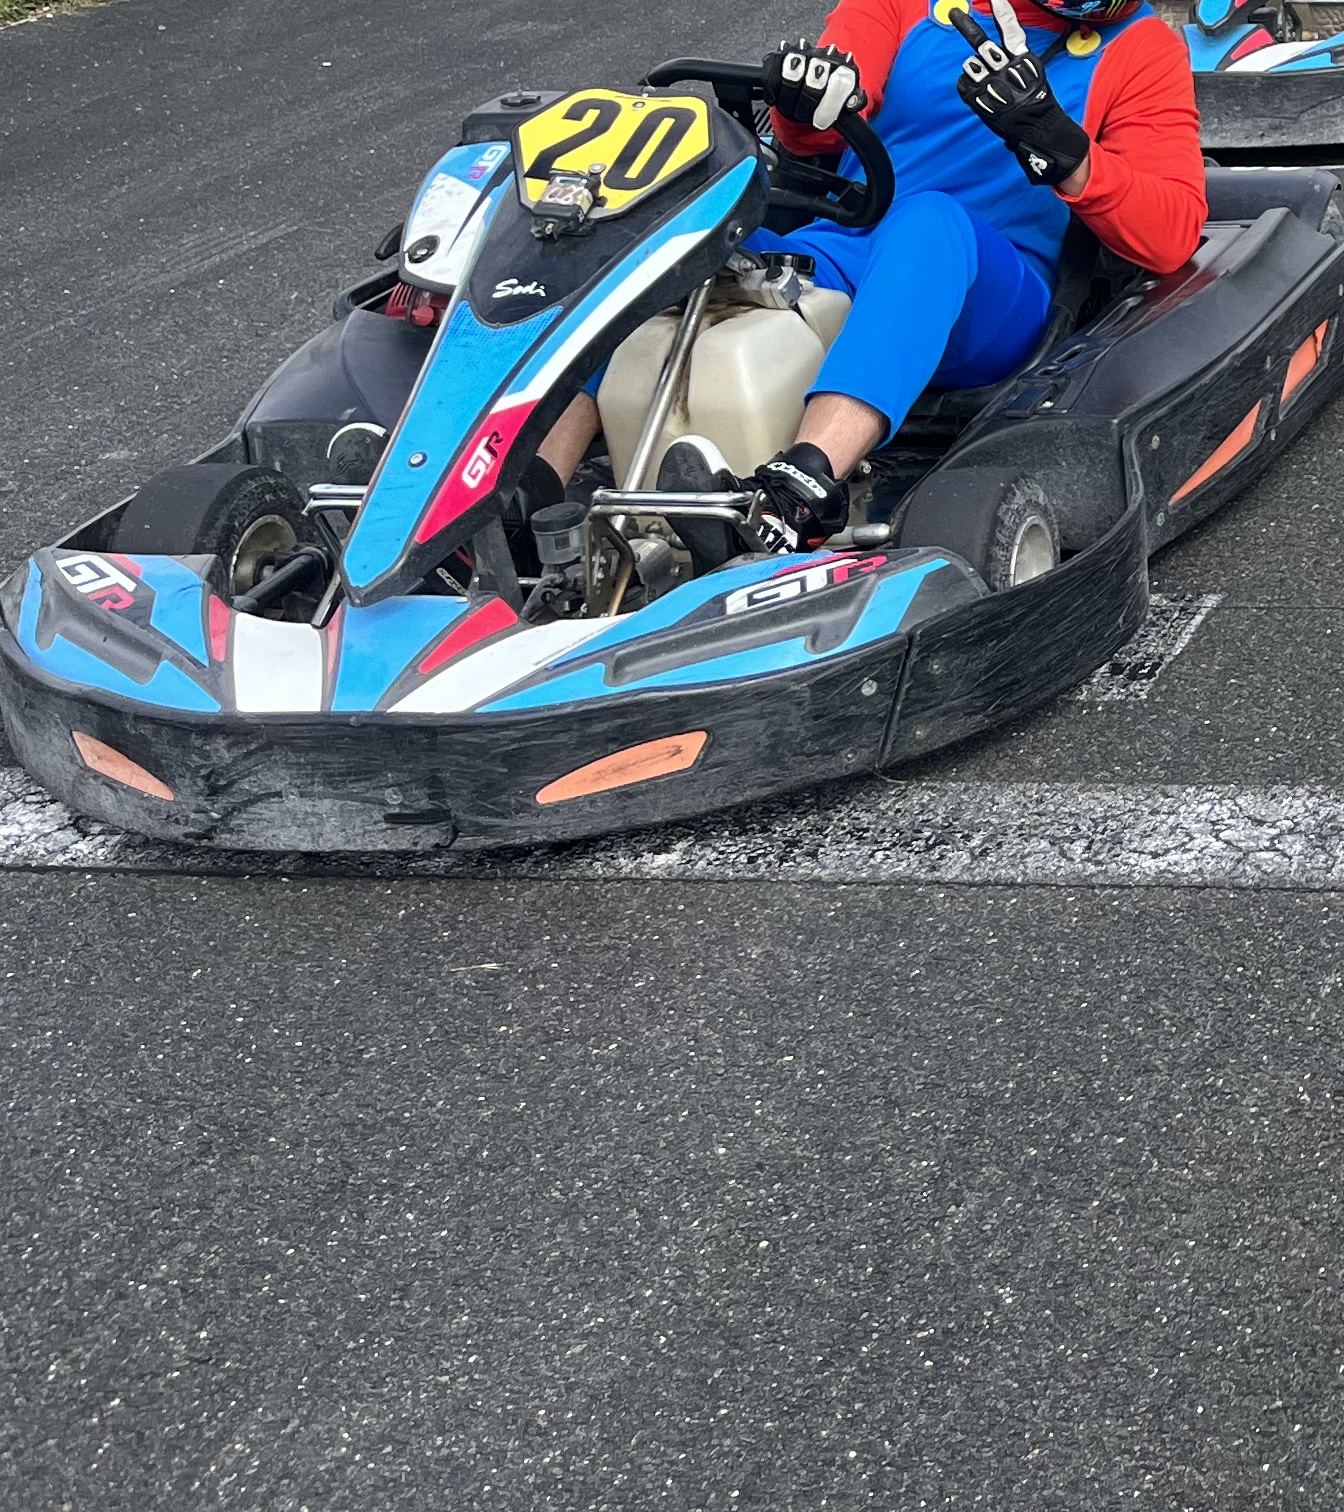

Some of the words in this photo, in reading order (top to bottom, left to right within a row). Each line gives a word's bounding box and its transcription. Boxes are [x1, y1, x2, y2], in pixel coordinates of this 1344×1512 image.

[523, 98, 698, 191] 20
[491, 277, 547, 299] Sodi
[462, 430, 504, 490] GTR
[55, 554, 135, 611] GTR
[725, 554, 889, 616] GTR
